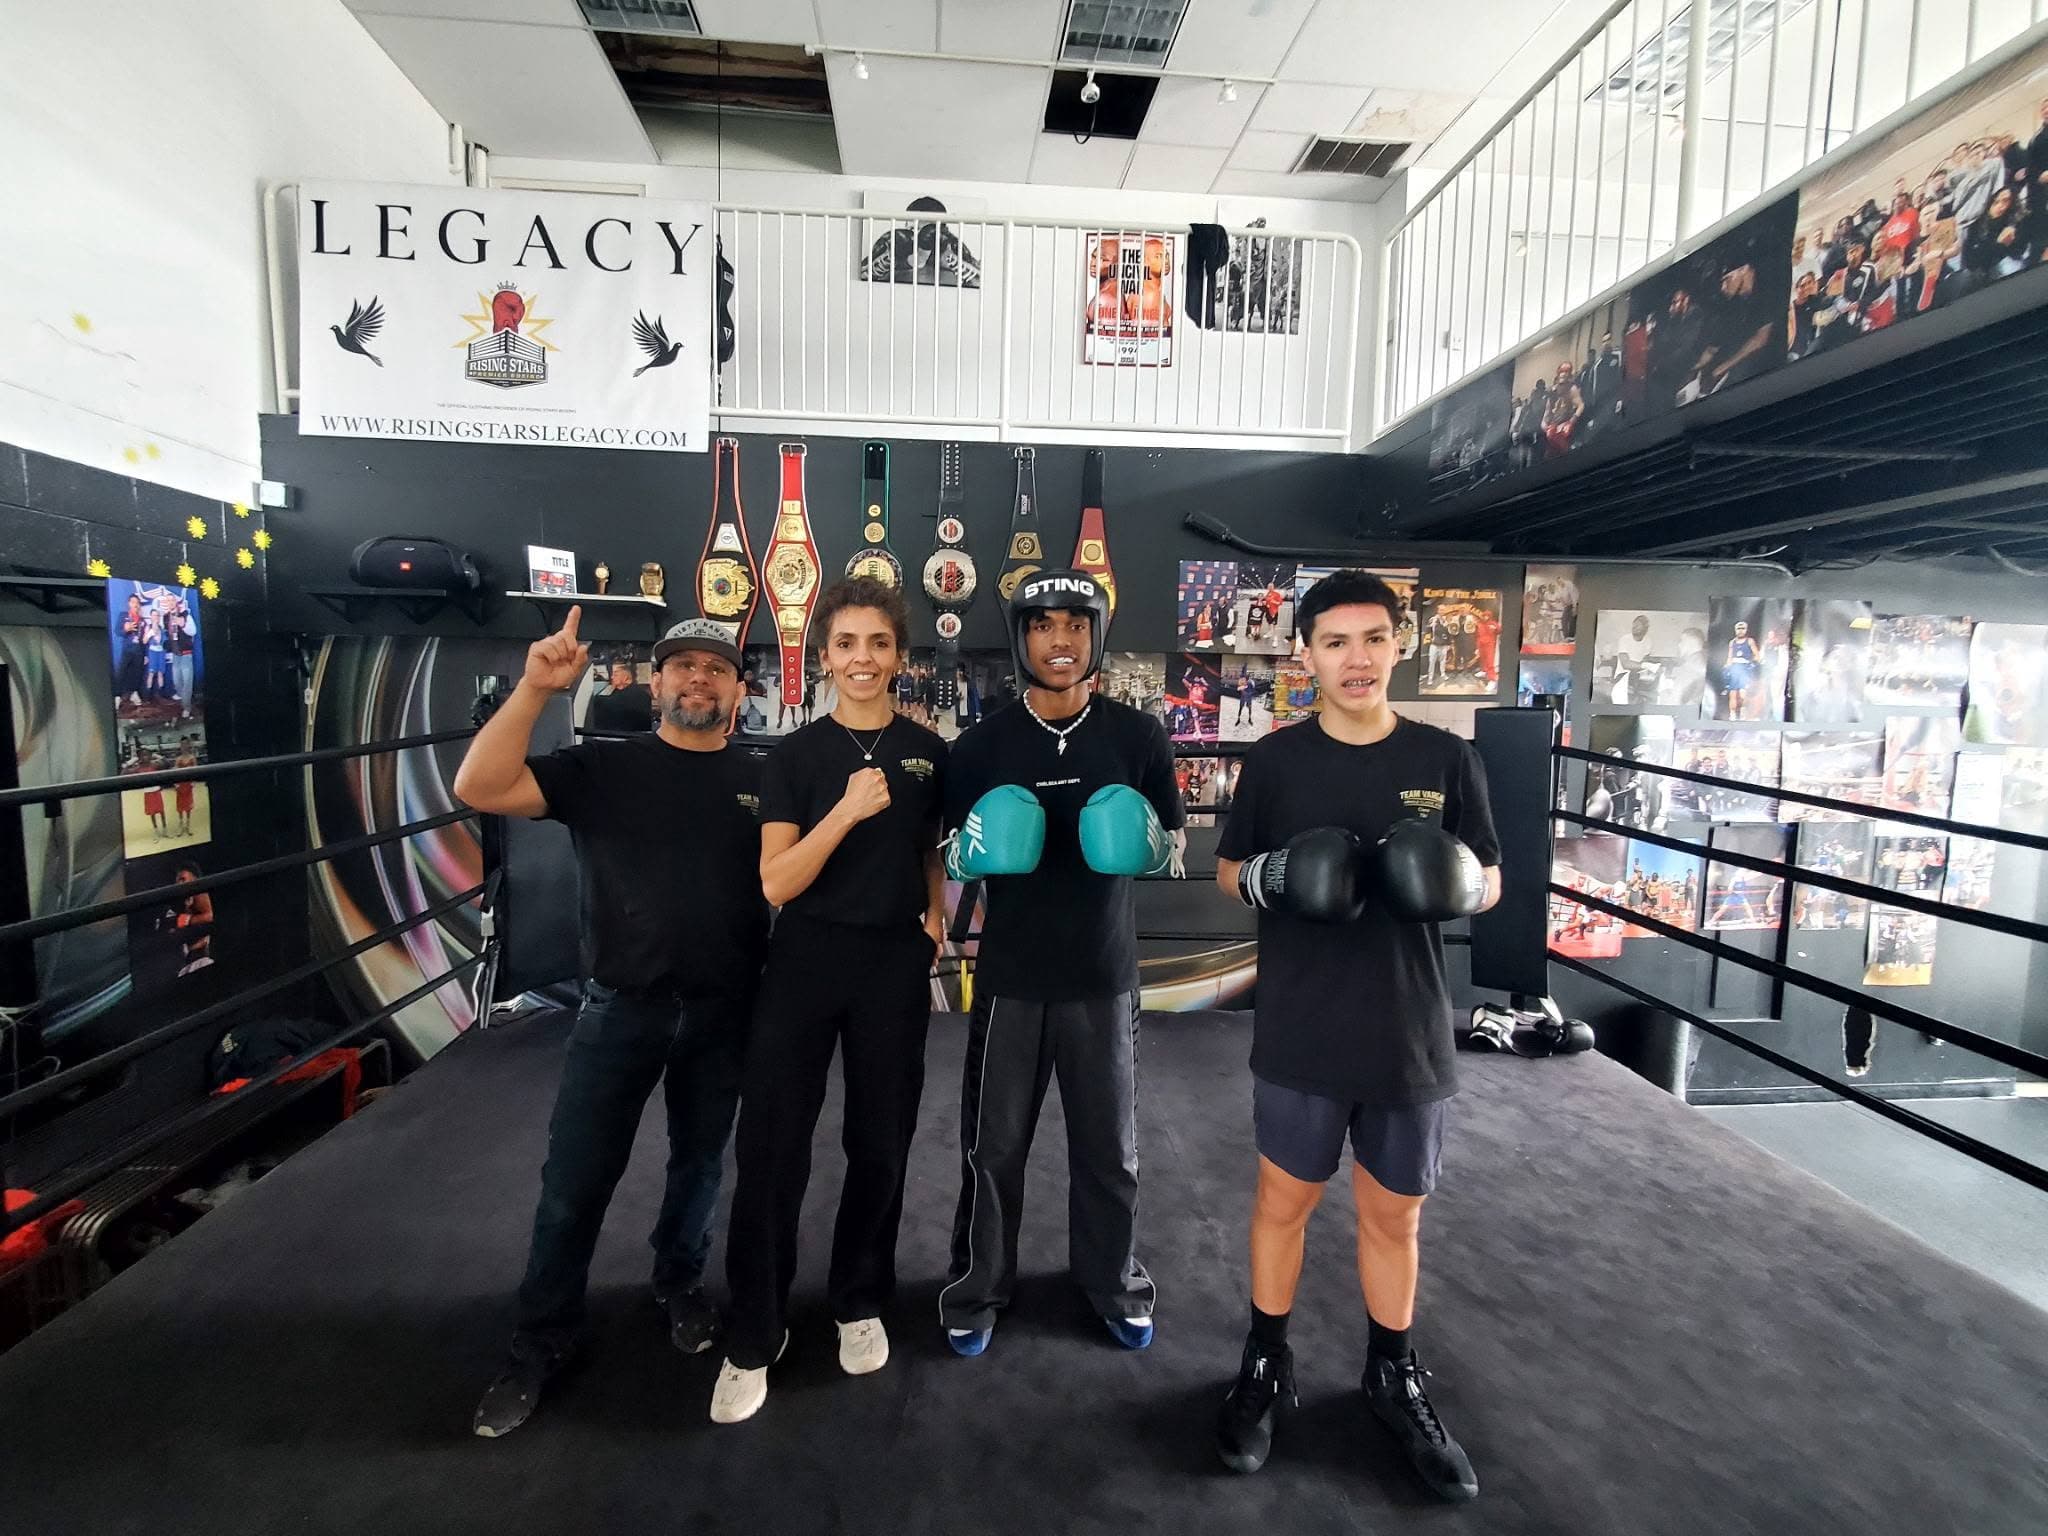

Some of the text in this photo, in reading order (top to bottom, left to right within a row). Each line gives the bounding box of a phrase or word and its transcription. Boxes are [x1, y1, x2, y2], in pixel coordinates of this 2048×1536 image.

[311, 200, 704, 275] LEGACY
[1122, 249, 1141, 264] THE
[469, 357, 544, 374] RISING STARS
[320, 415, 687, 447] WWW.RISINGSTARSLEGACY.COM
[552, 556, 569, 568] TITLE
[1024, 578, 1095, 600] STING
[901, 758, 918, 767] TEAM
[1400, 790, 1421, 800] TEAM
[1265, 851, 1282, 891] BOXING
